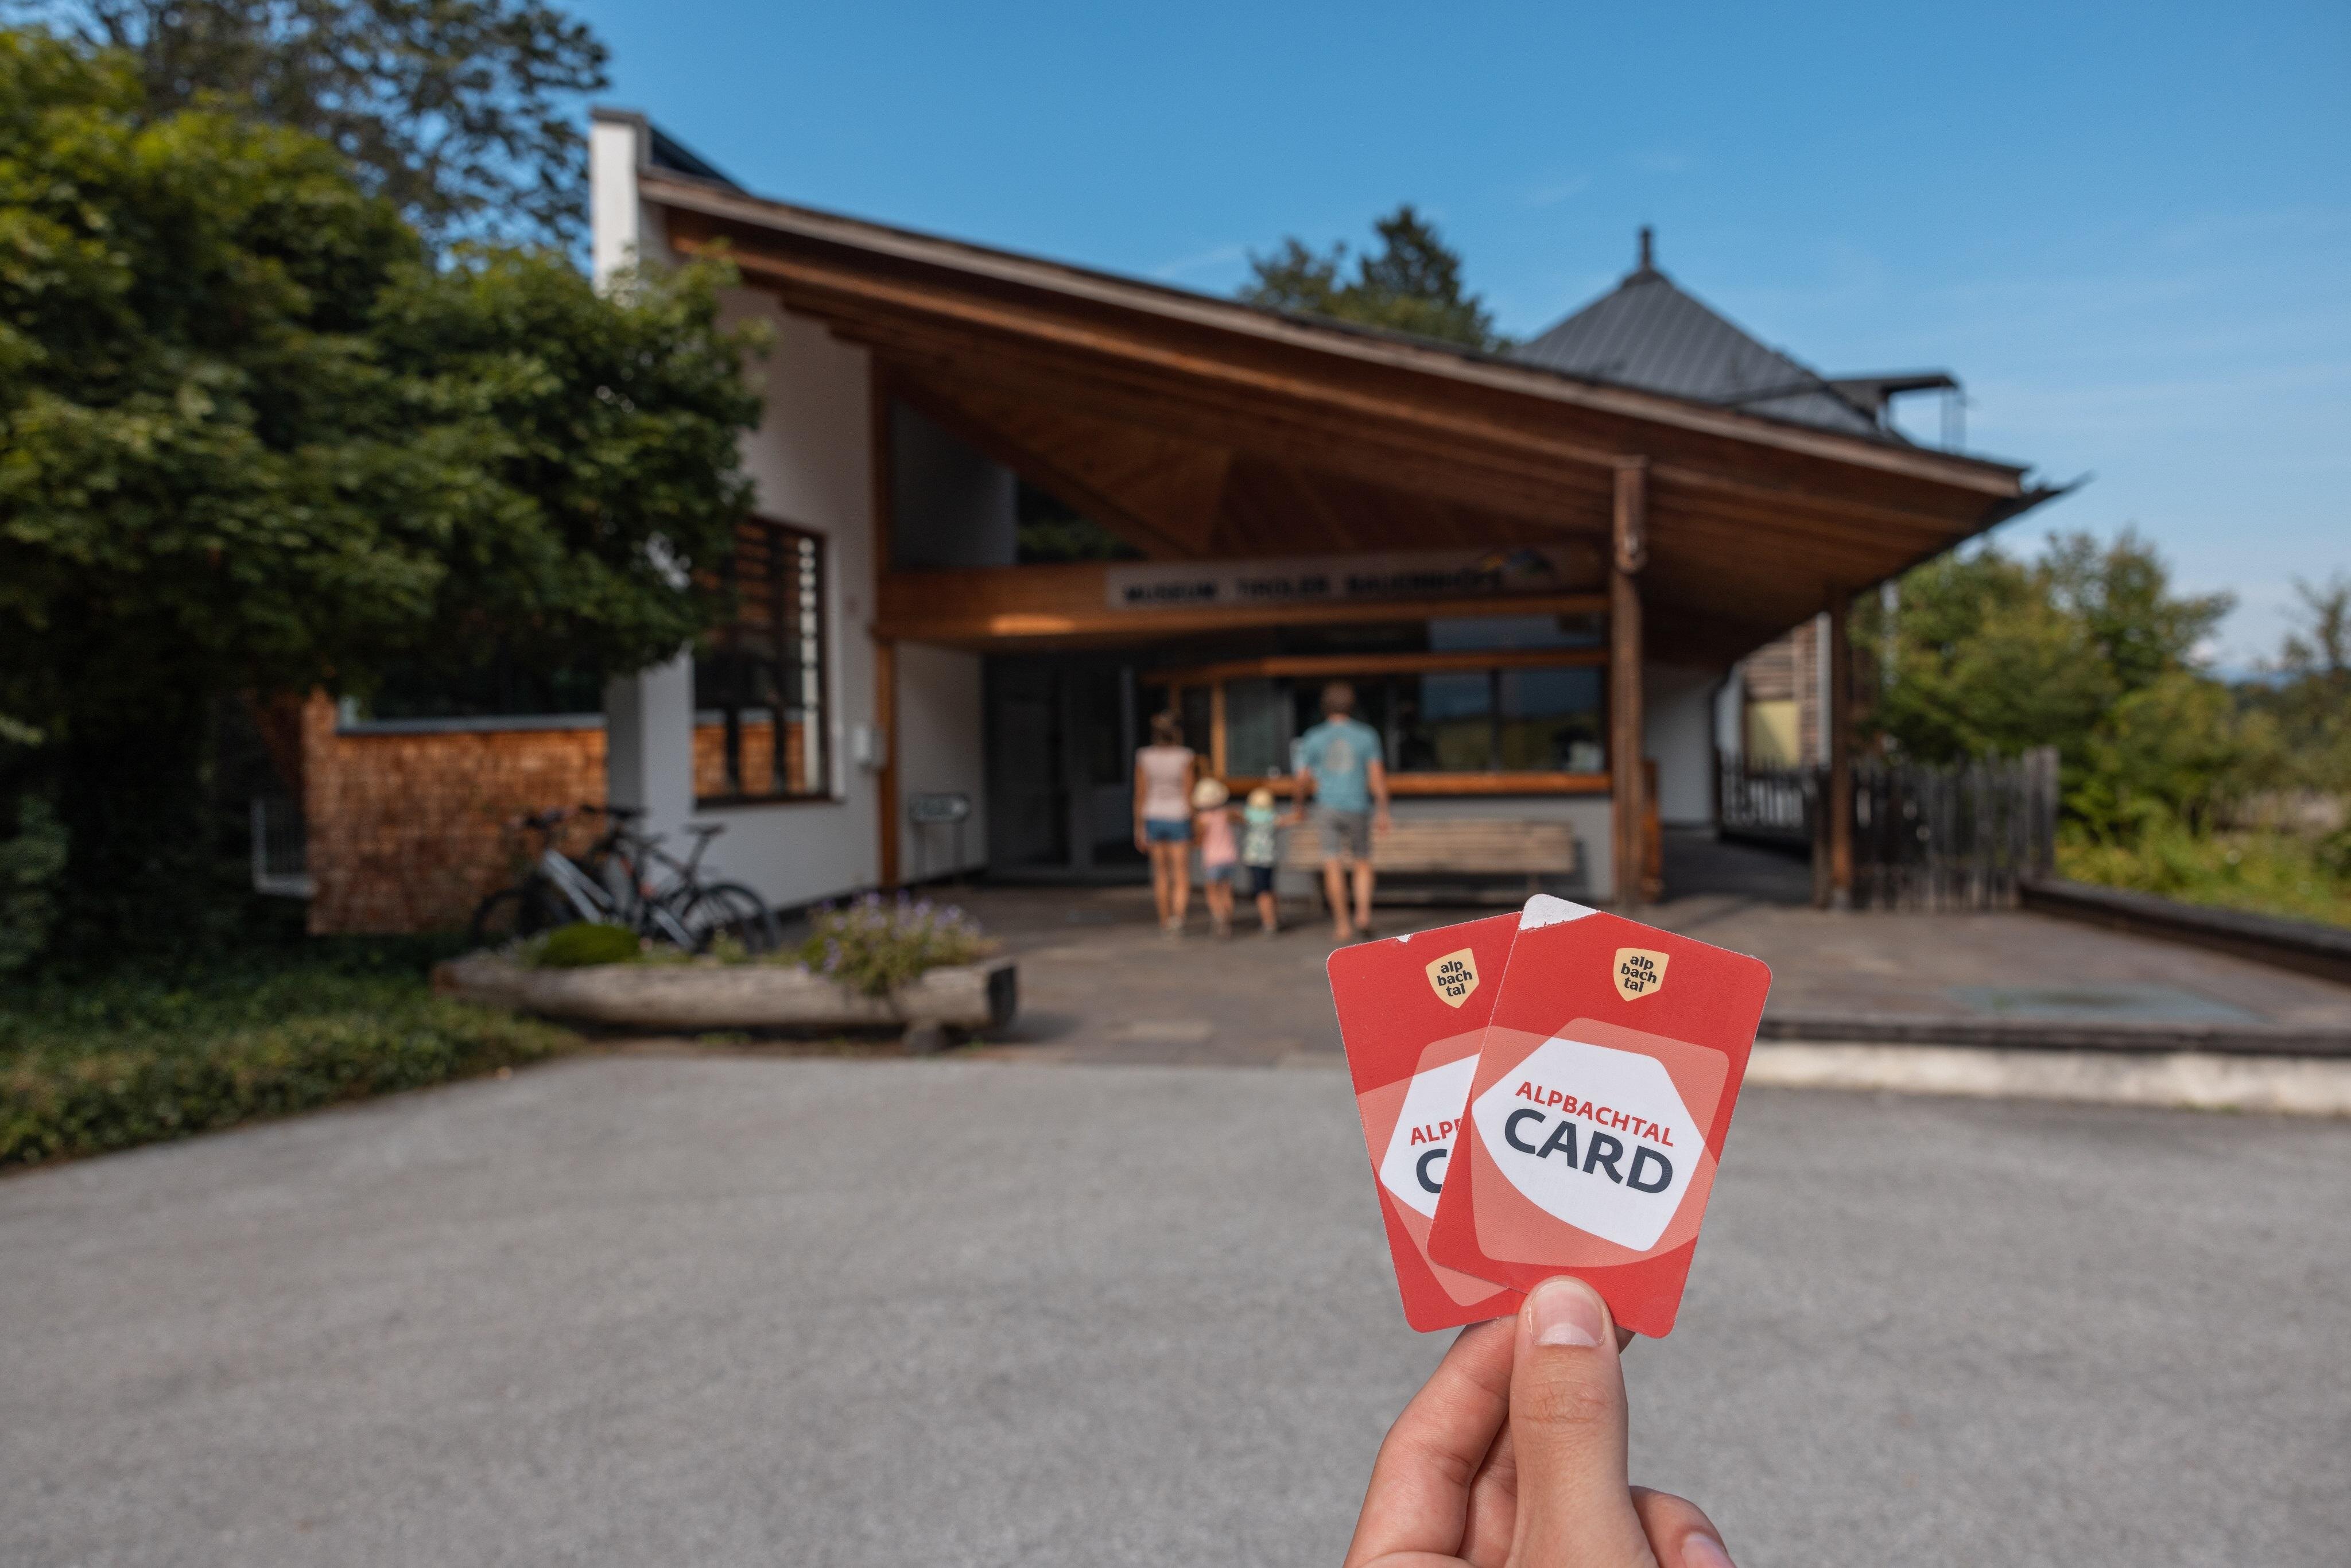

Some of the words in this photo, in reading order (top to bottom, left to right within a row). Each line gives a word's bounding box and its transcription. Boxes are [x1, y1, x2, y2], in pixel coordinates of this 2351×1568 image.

[1441, 961, 1463, 974] alp
[1630, 956, 1654, 970] alp
[1437, 970, 1473, 986] bach
[1620, 962, 1657, 984] bach
[1446, 983, 1466, 997] tal
[1624, 977, 1644, 992] tal
[1515, 1081, 1674, 1147] ALPBACHTAL
[1504, 1108, 1673, 1194] CARD
